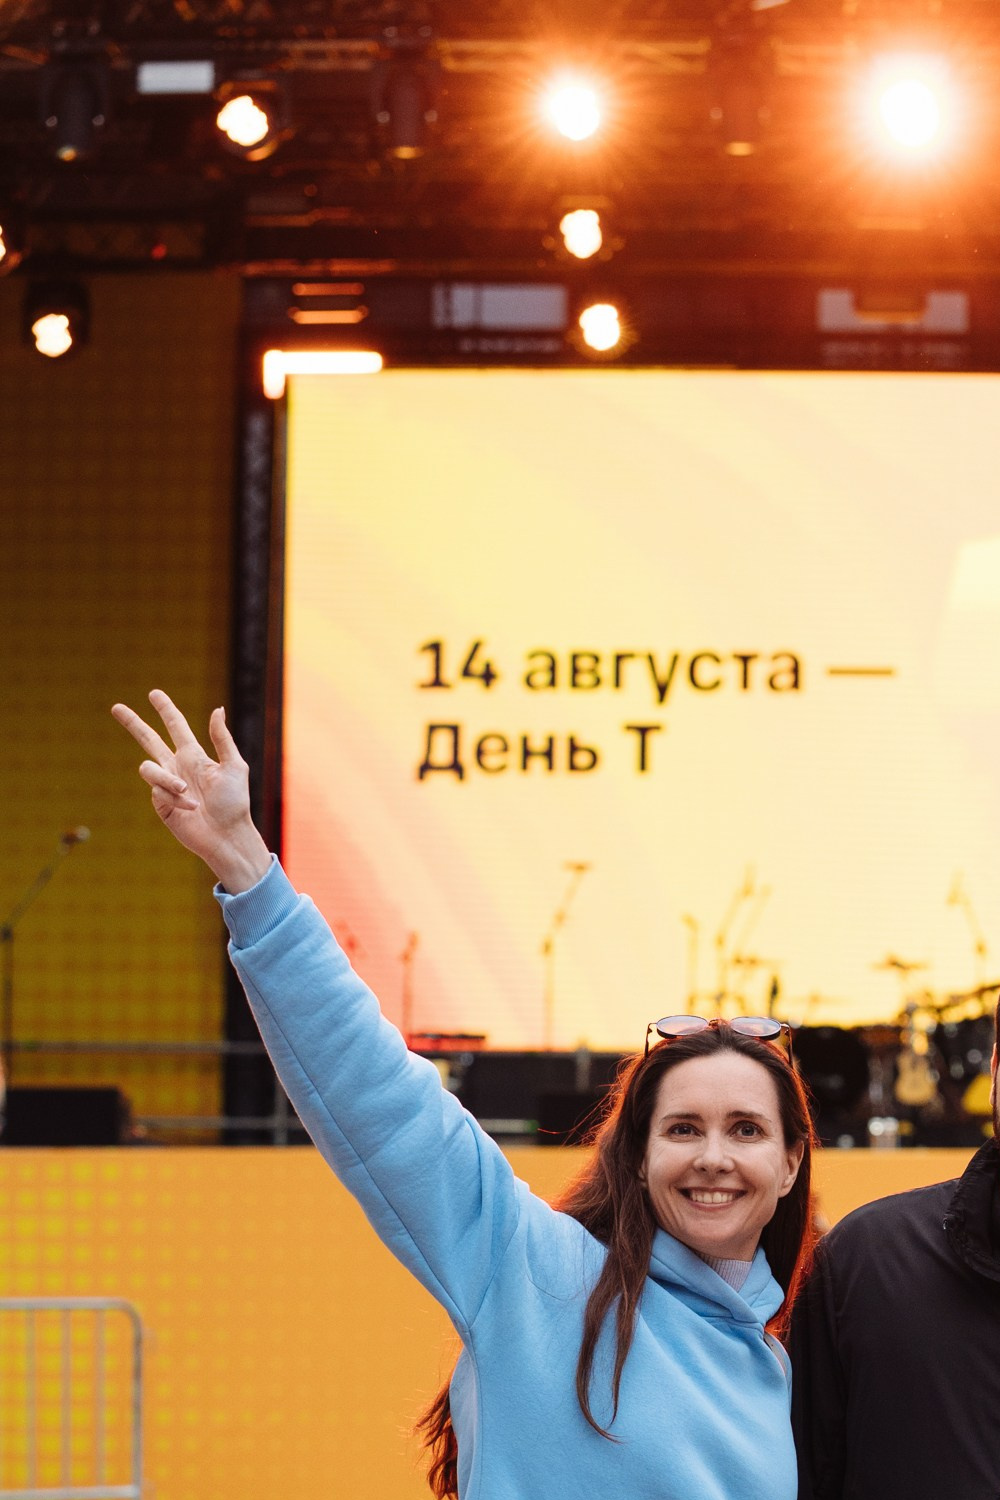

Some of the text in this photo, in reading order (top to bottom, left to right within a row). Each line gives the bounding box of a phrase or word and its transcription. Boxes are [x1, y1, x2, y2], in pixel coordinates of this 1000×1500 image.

[418, 640, 498, 690] 14
[524, 648, 803, 705] августа
[417, 723, 662, 781] День Т
